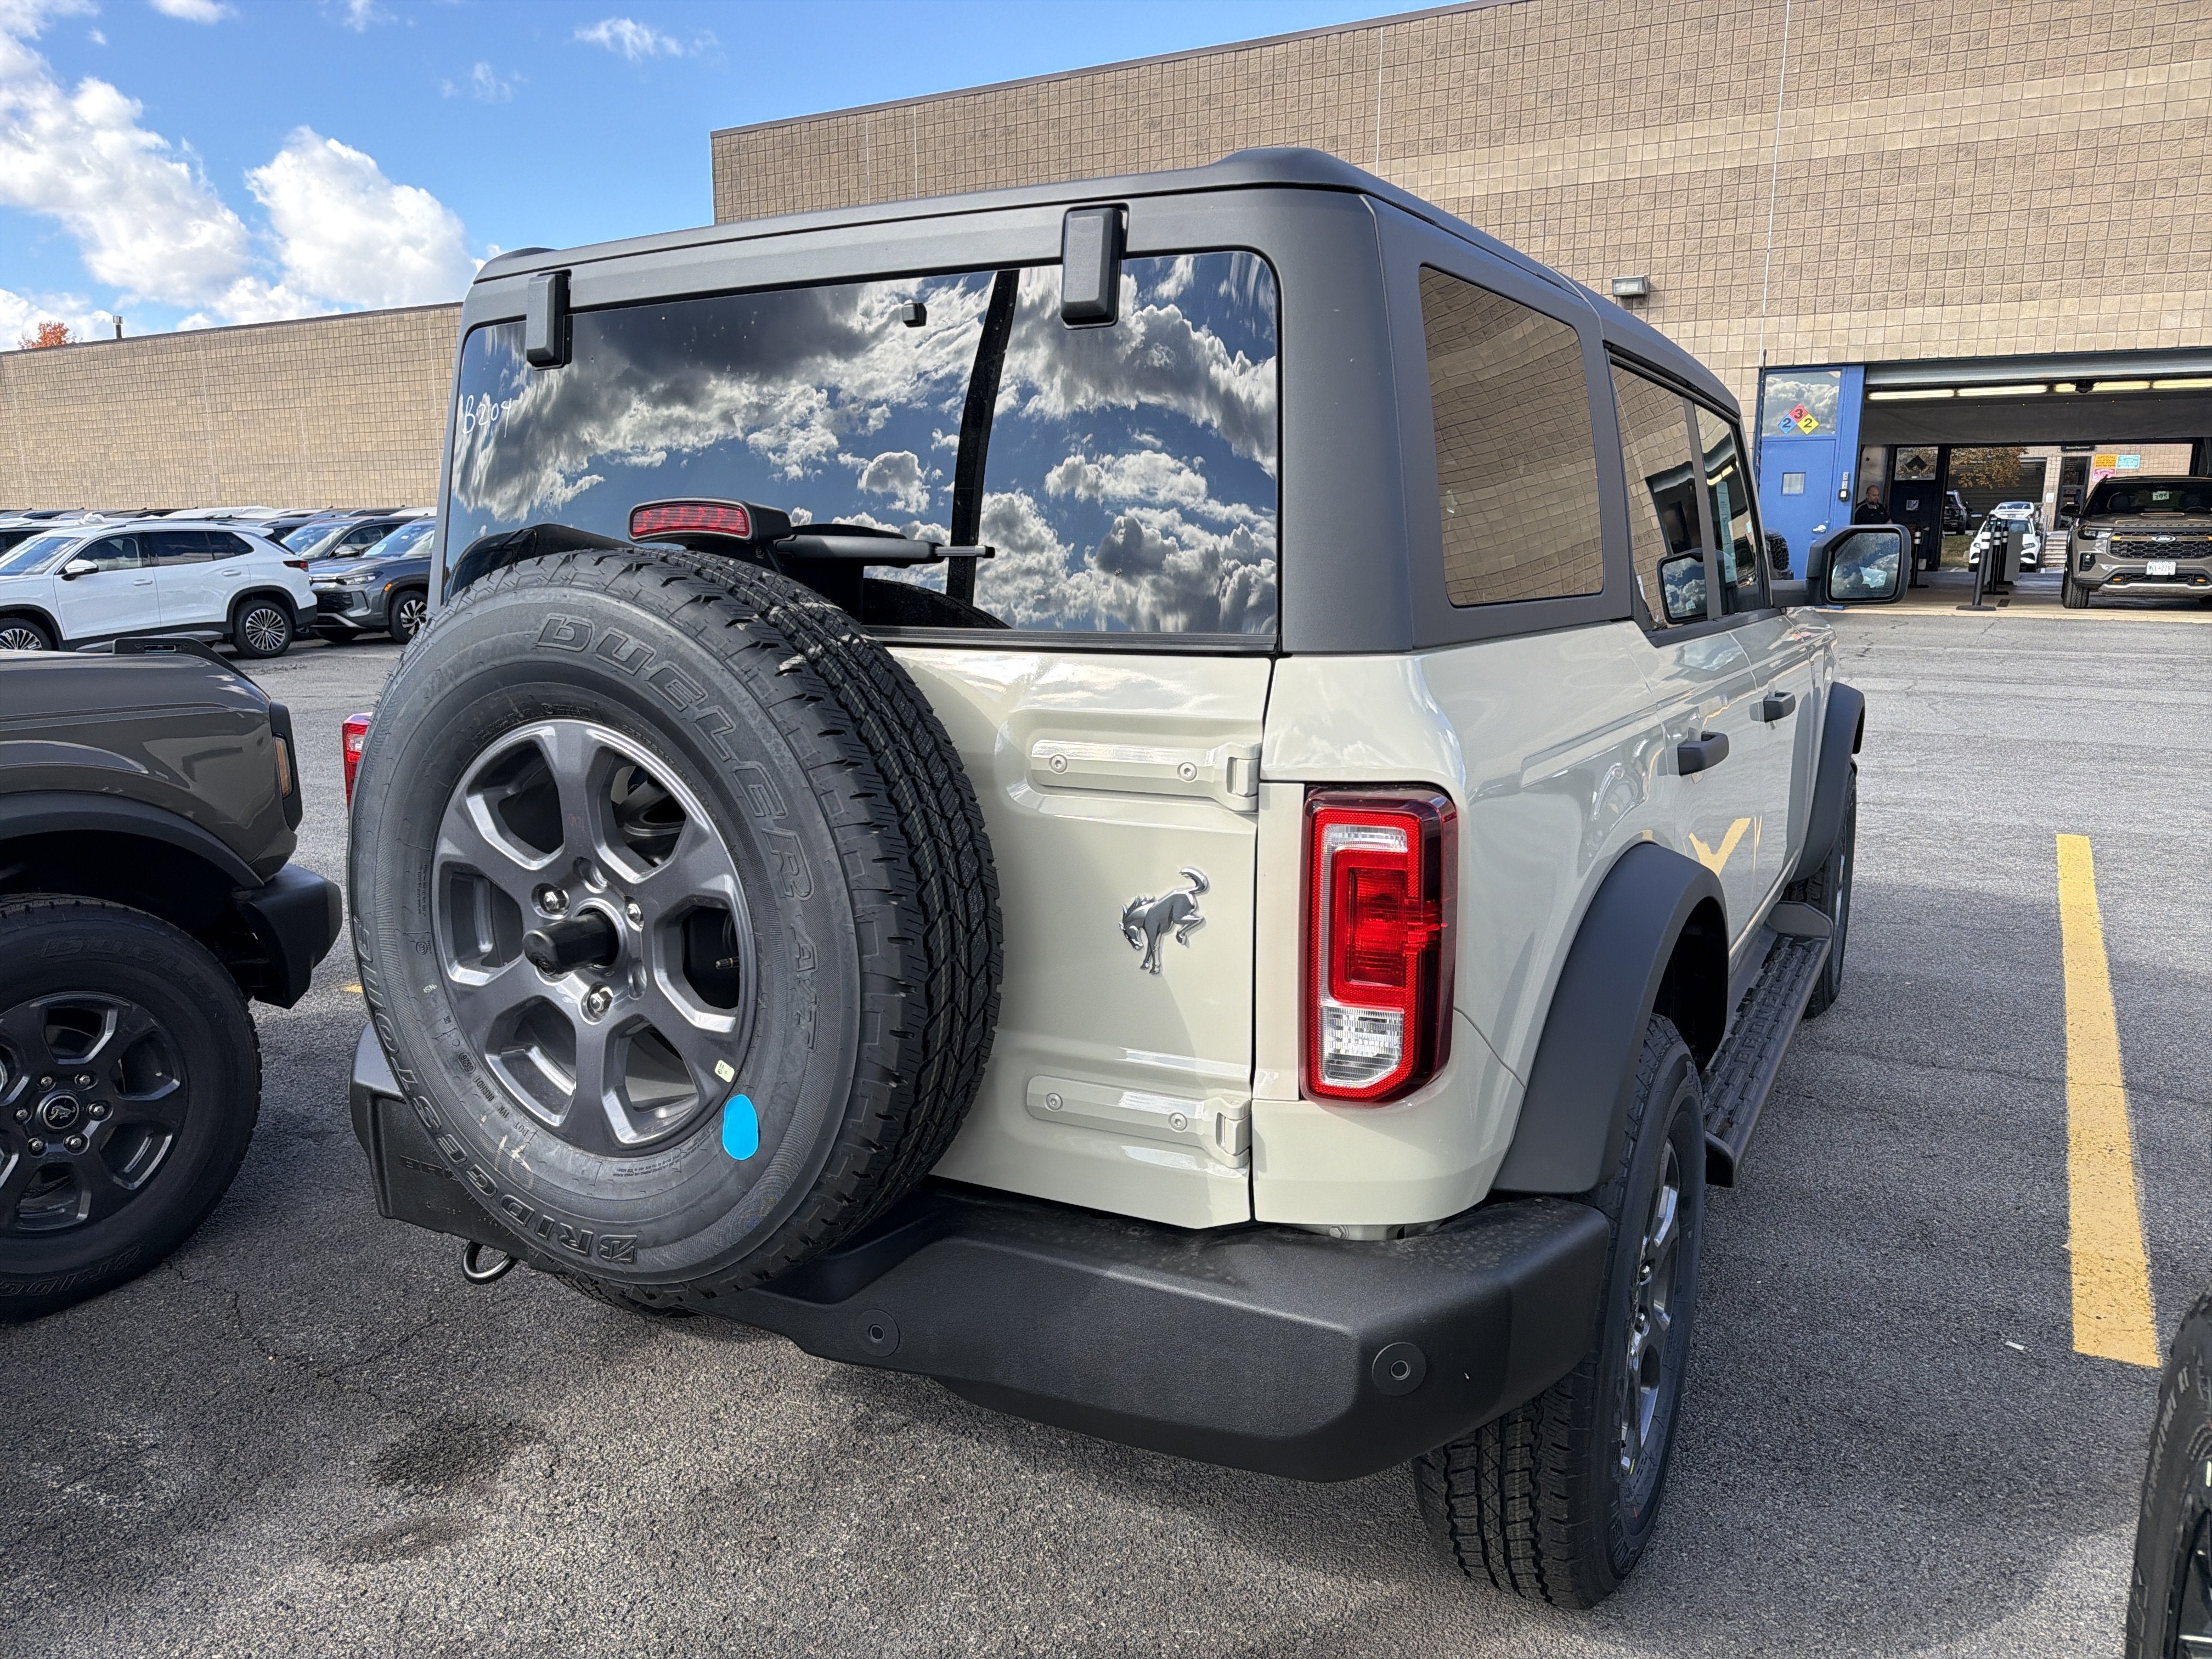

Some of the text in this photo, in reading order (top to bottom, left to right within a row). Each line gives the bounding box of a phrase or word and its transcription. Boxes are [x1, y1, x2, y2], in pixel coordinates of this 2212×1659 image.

[462, 394, 512, 438] B204
[1782, 417, 1792, 428] 2
[1794, 408, 1803, 419] 3
[1803, 417, 1813, 428] 2
[534, 612, 815, 901] DUELER
[353, 915, 639, 1266] BRIDGESTONE
